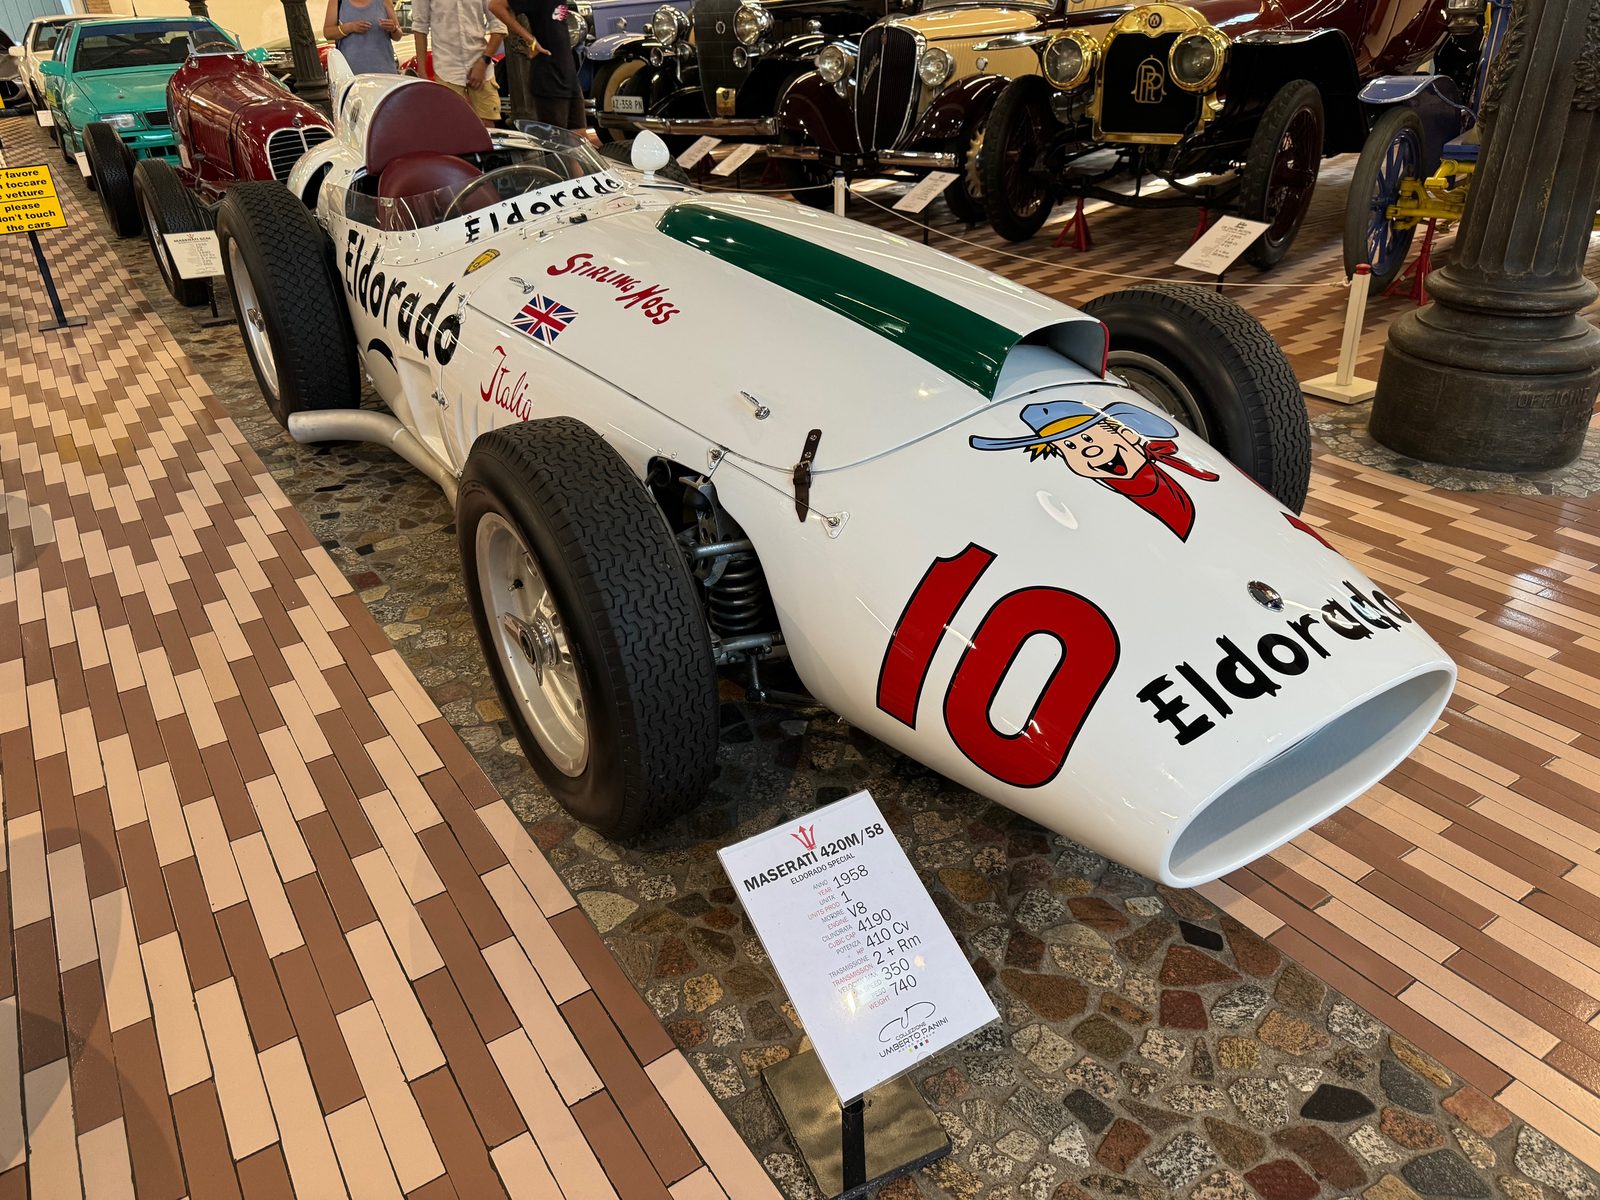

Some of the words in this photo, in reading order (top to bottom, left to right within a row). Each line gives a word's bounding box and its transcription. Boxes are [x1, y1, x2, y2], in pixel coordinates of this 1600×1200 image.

[5, 170, 39, 179] favore
[5, 179, 47, 189] toccare
[5, 189, 44, 199] vetture
[4, 202, 40, 213] please
[25, 209, 56, 220] touch
[464, 175, 621, 244] Eldorado
[6, 224, 25, 232] the
[27, 221, 51, 229] cars
[346, 229, 461, 365] Eldorado
[875, 541, 1121, 789] 10
[1136, 579, 1413, 746] Eldorado
[743, 851, 818, 892] MASERATI
[820, 822, 884, 858] 420M/58
[790, 864, 827, 885] ELDORADO
[827, 852, 855, 869] SPECIAL
[832, 864, 869, 889] 1958
[812, 879, 829, 890] ANNO
[817, 886, 832, 896] YEAR
[841, 890, 852, 904] 1
[807, 909, 825, 920] UNITS
[824, 901, 840, 913] PROD
[821, 908, 844, 923] MOTORE
[846, 901, 868, 918] V8
[827, 916, 849, 930] ENGINE
[858, 908, 892, 933] 4190
[821, 924, 853, 943] CILINDRATA
[828, 937, 846, 949] CUBIC
[845, 931, 856, 941] CAP
[866, 927, 891, 948] 410
[892, 920, 910, 935] Cv
[836, 940, 861, 954] POTENZA
[856, 947, 864, 955] HP
[873, 950, 885, 965] 2
[887, 947, 895, 956] +
[897, 934, 922, 953] Rm
[828, 955, 870, 979] TRASMISSIONE
[832, 963, 874, 987] TRANSMISSION
[881, 957, 910, 981] 350
[889, 974, 917, 997] 740
[868, 995, 890, 1010] WEIGHT
[879, 1032, 920, 1058] UMBERTO
[921, 1016, 949, 1035] PANINI
[896, 1021, 927, 1041] COLLEZIONE
